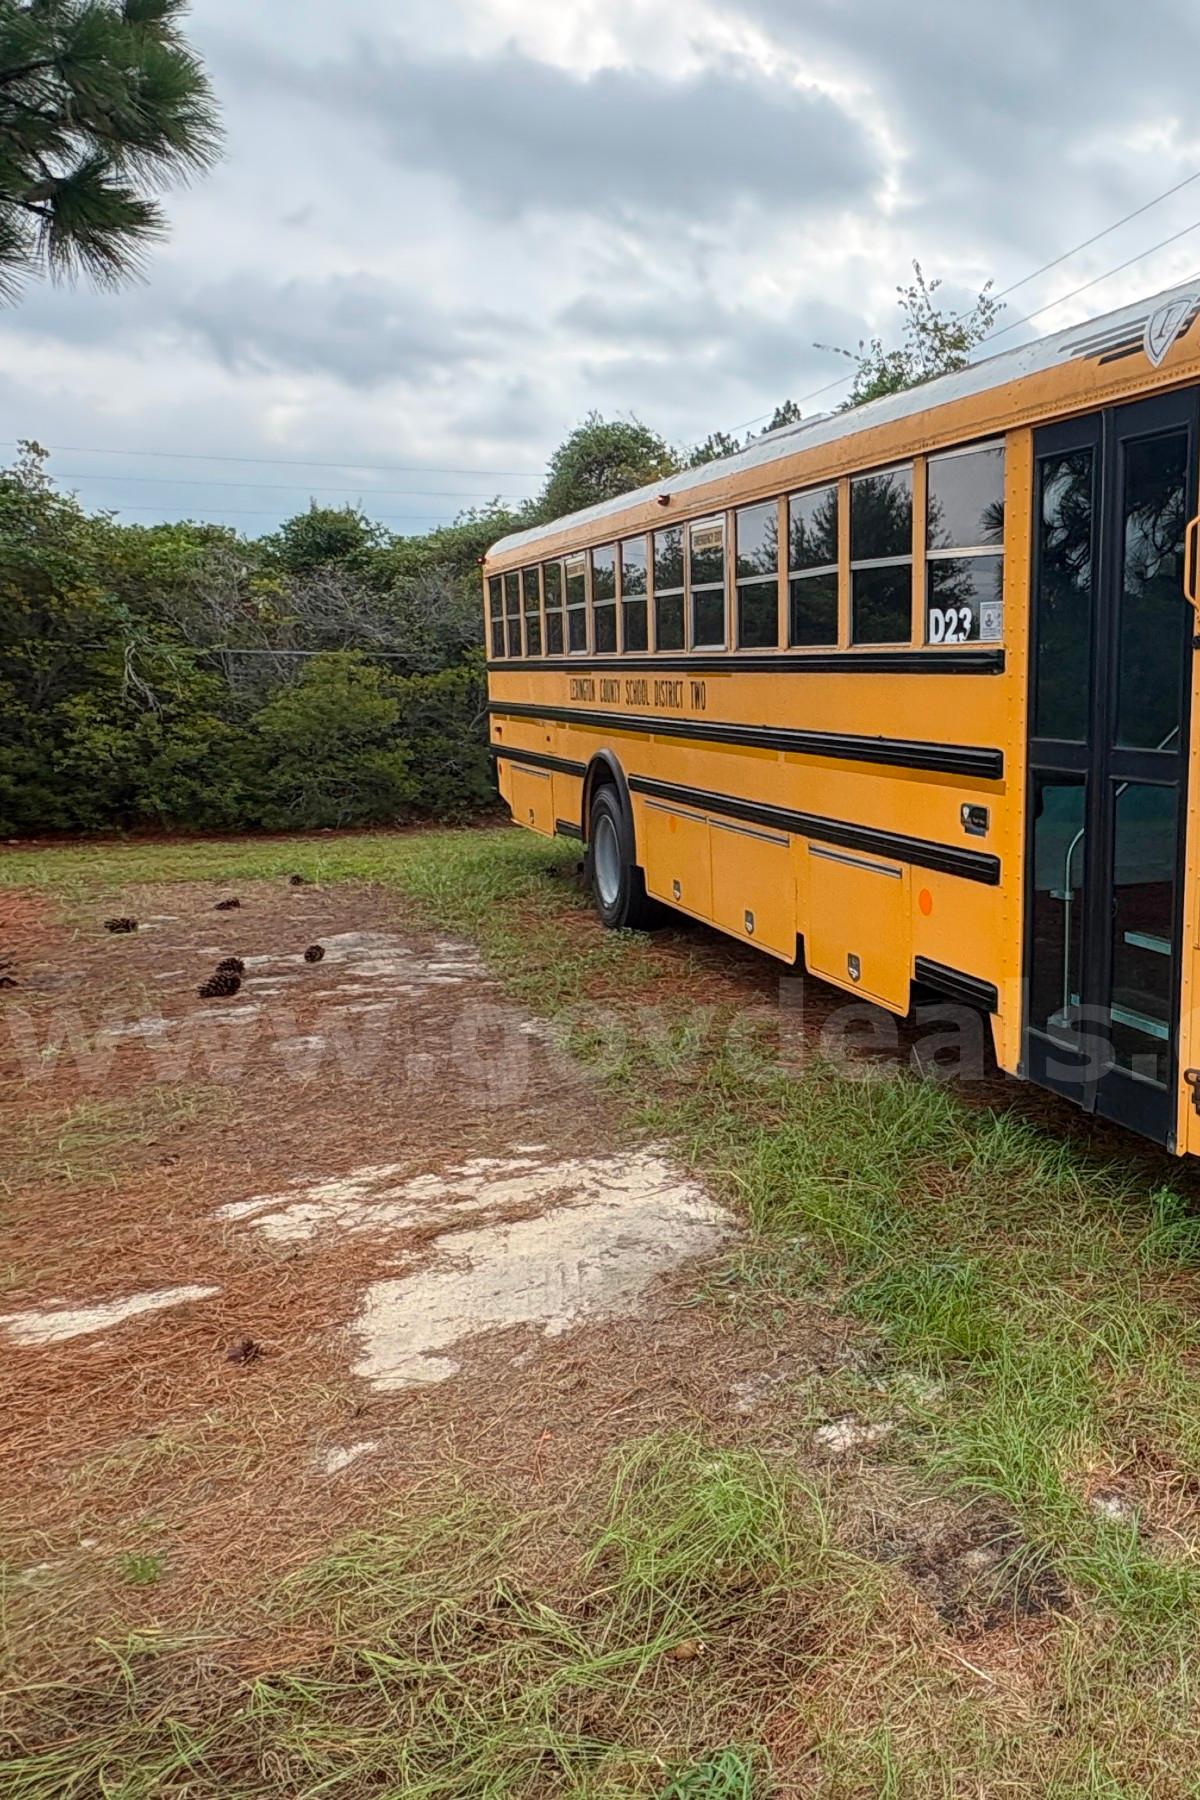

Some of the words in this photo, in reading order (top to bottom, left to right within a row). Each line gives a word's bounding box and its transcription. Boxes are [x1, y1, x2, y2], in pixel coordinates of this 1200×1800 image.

[929, 607, 972, 643] D23
[600, 678, 620, 703] COUNTY
[625, 679, 649, 705] SCHOOL
[654, 680, 683, 709] DISTRICT
[690, 681, 706, 710] TWO
